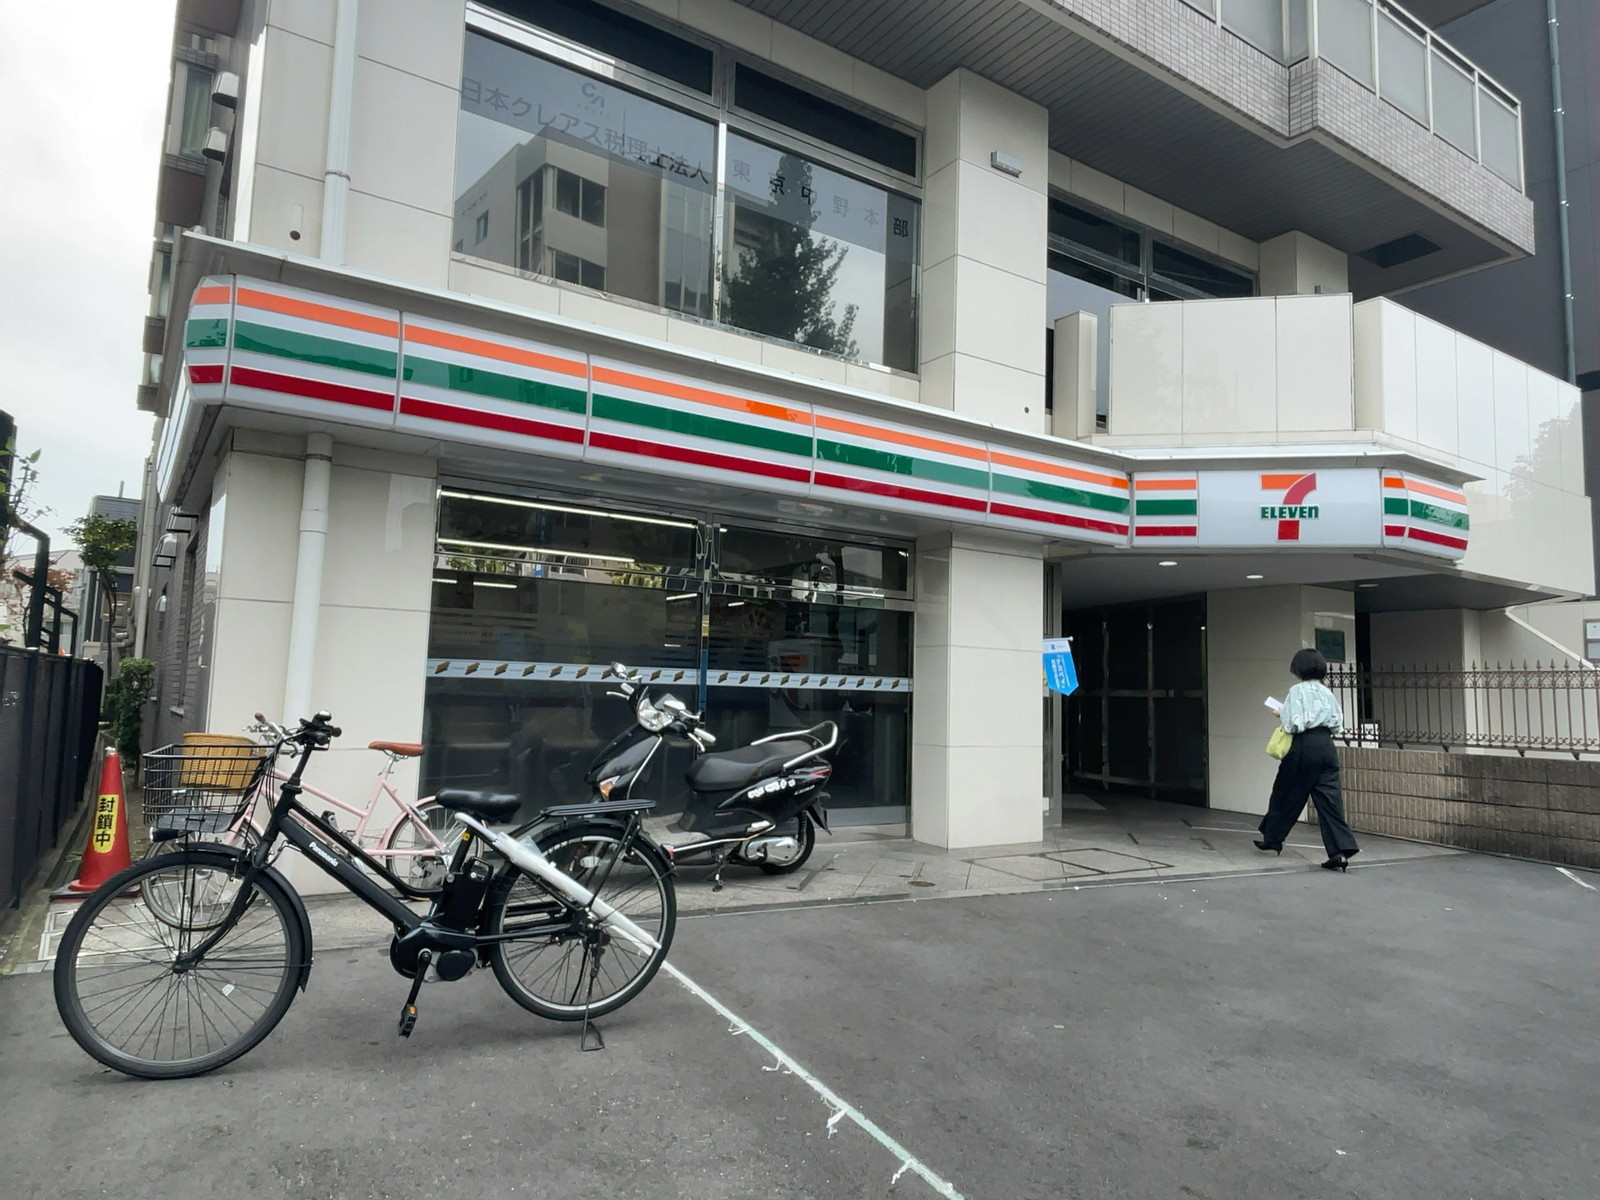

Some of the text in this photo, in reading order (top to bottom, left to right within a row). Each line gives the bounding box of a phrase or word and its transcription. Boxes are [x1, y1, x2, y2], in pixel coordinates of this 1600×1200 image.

[461, 76, 909, 238] 日本クレアス税理士法人 東京中野本部
[1260, 472, 1317, 541] 7
[95, 797, 116, 848] 封鎖中
[308, 841, 339, 867] Panasonic
